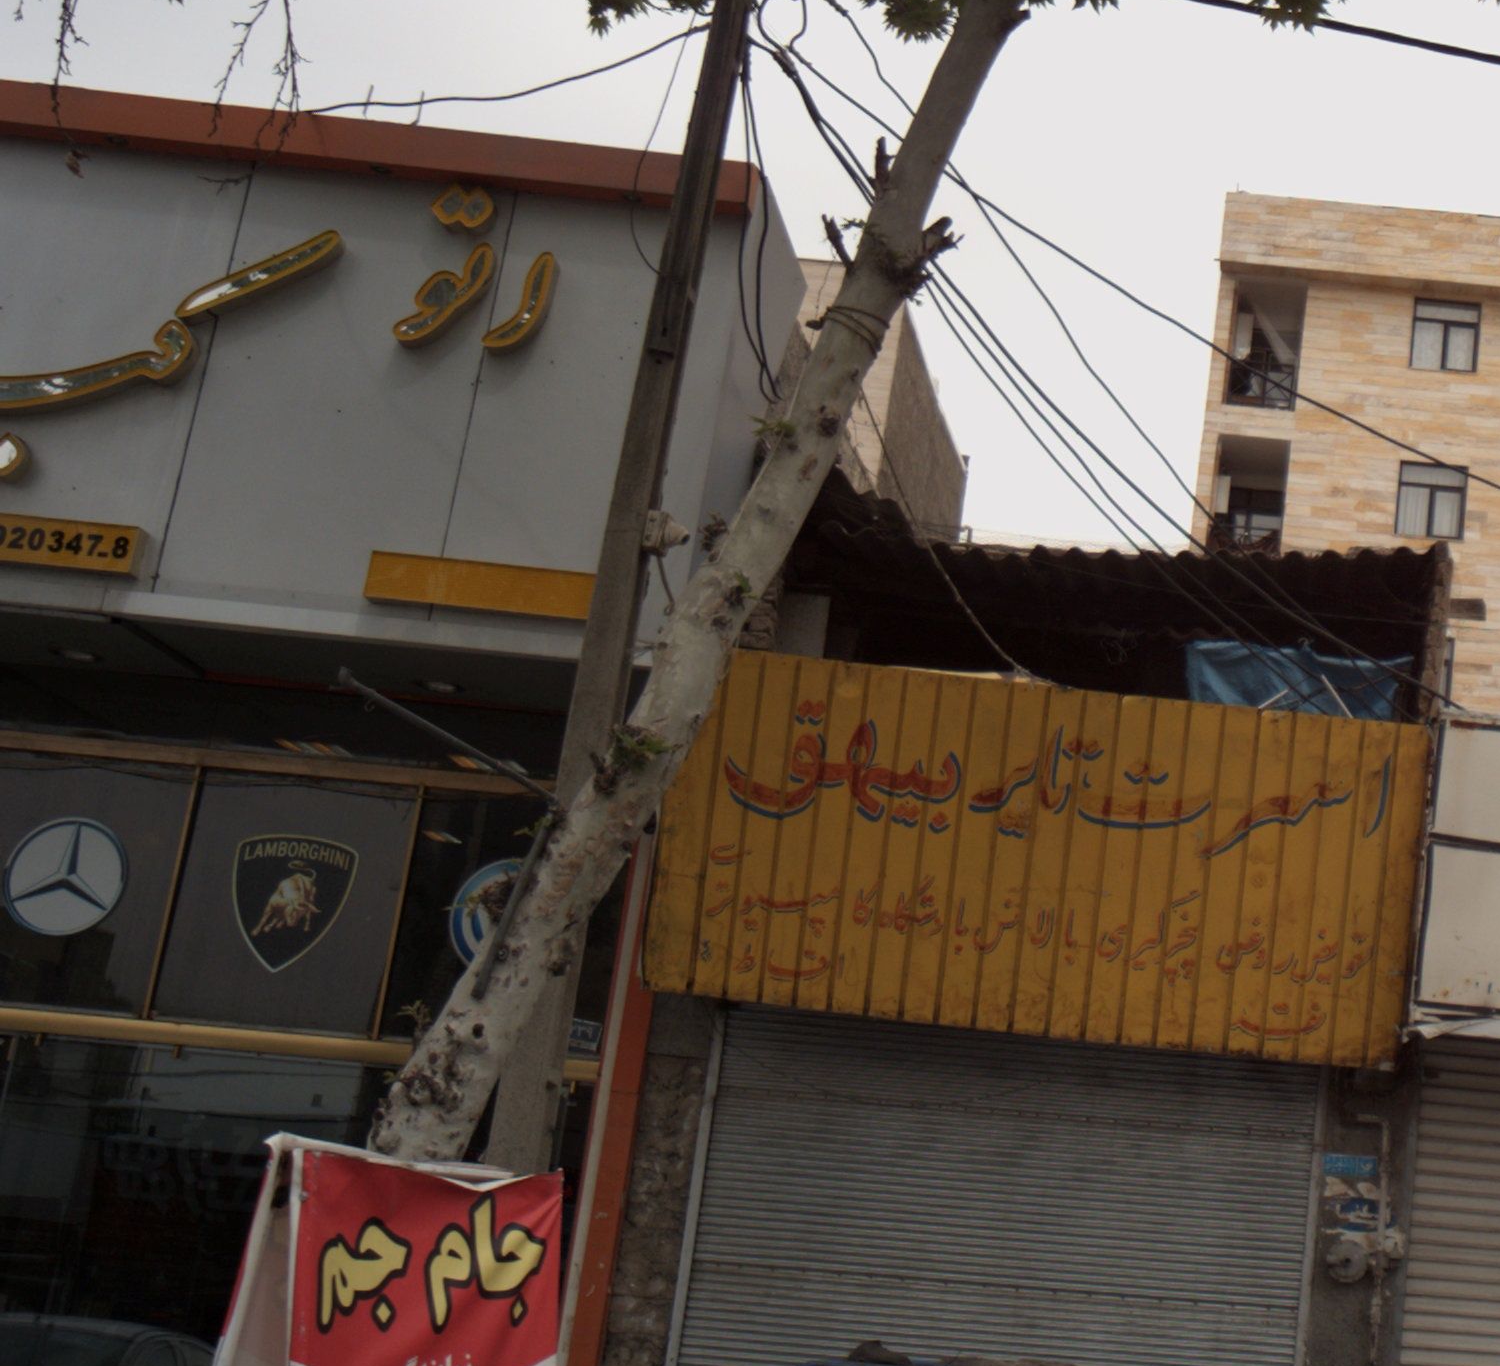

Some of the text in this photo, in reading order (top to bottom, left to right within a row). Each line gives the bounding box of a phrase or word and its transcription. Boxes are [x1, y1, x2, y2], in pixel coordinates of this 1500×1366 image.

[243, 839, 352, 872] LAMBORGHINI
[316, 1191, 547, 1335] جام جم
